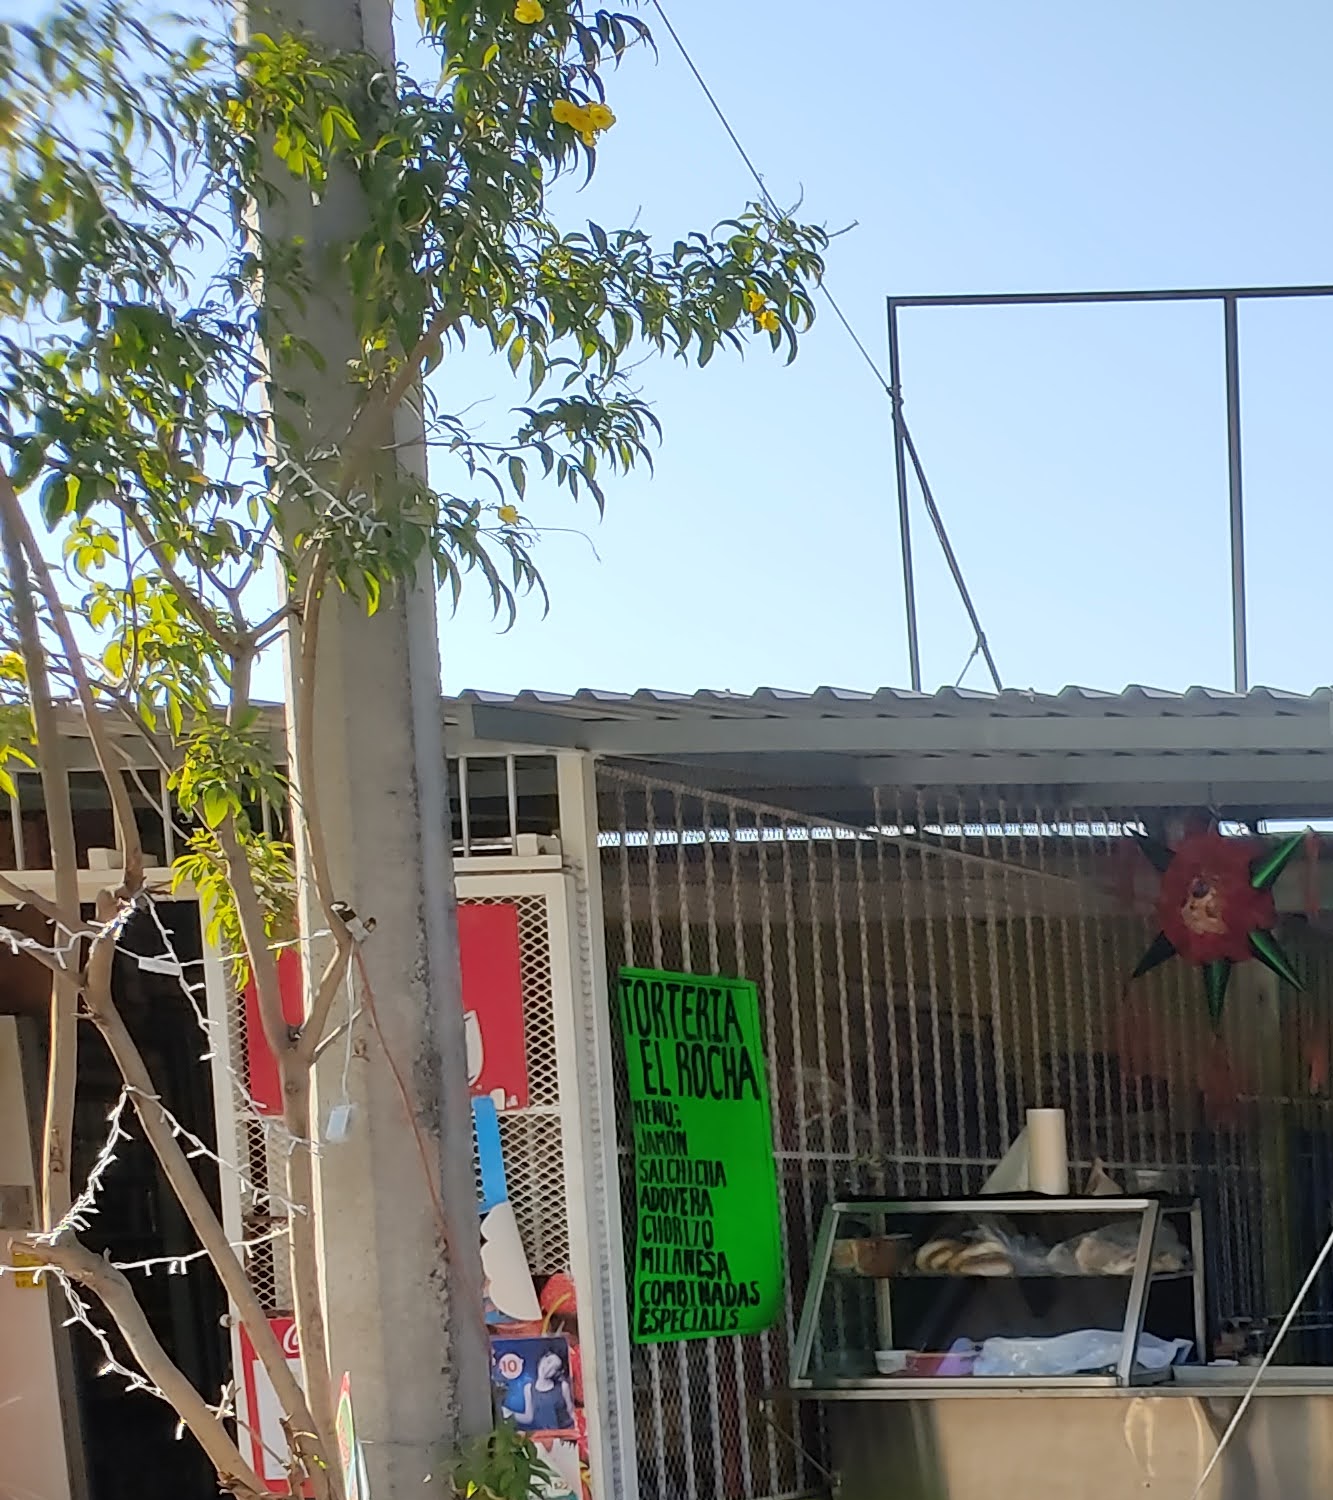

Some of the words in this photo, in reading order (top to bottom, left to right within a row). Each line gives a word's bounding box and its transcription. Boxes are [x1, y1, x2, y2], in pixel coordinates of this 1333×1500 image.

[619, 978, 744, 1044] TORTERIA
[639, 1039, 672, 1097] EL
[675, 1042, 762, 1101] ROCHA
[638, 1130, 689, 1156] JAMON
[639, 1158, 727, 1188] SALCHICHA
[640, 1185, 714, 1217] ADOVERA
[642, 1214, 714, 1249] CHORIZO
[640, 1248, 732, 1281] MILANESA
[639, 1280, 761, 1308] COMBINADAS
